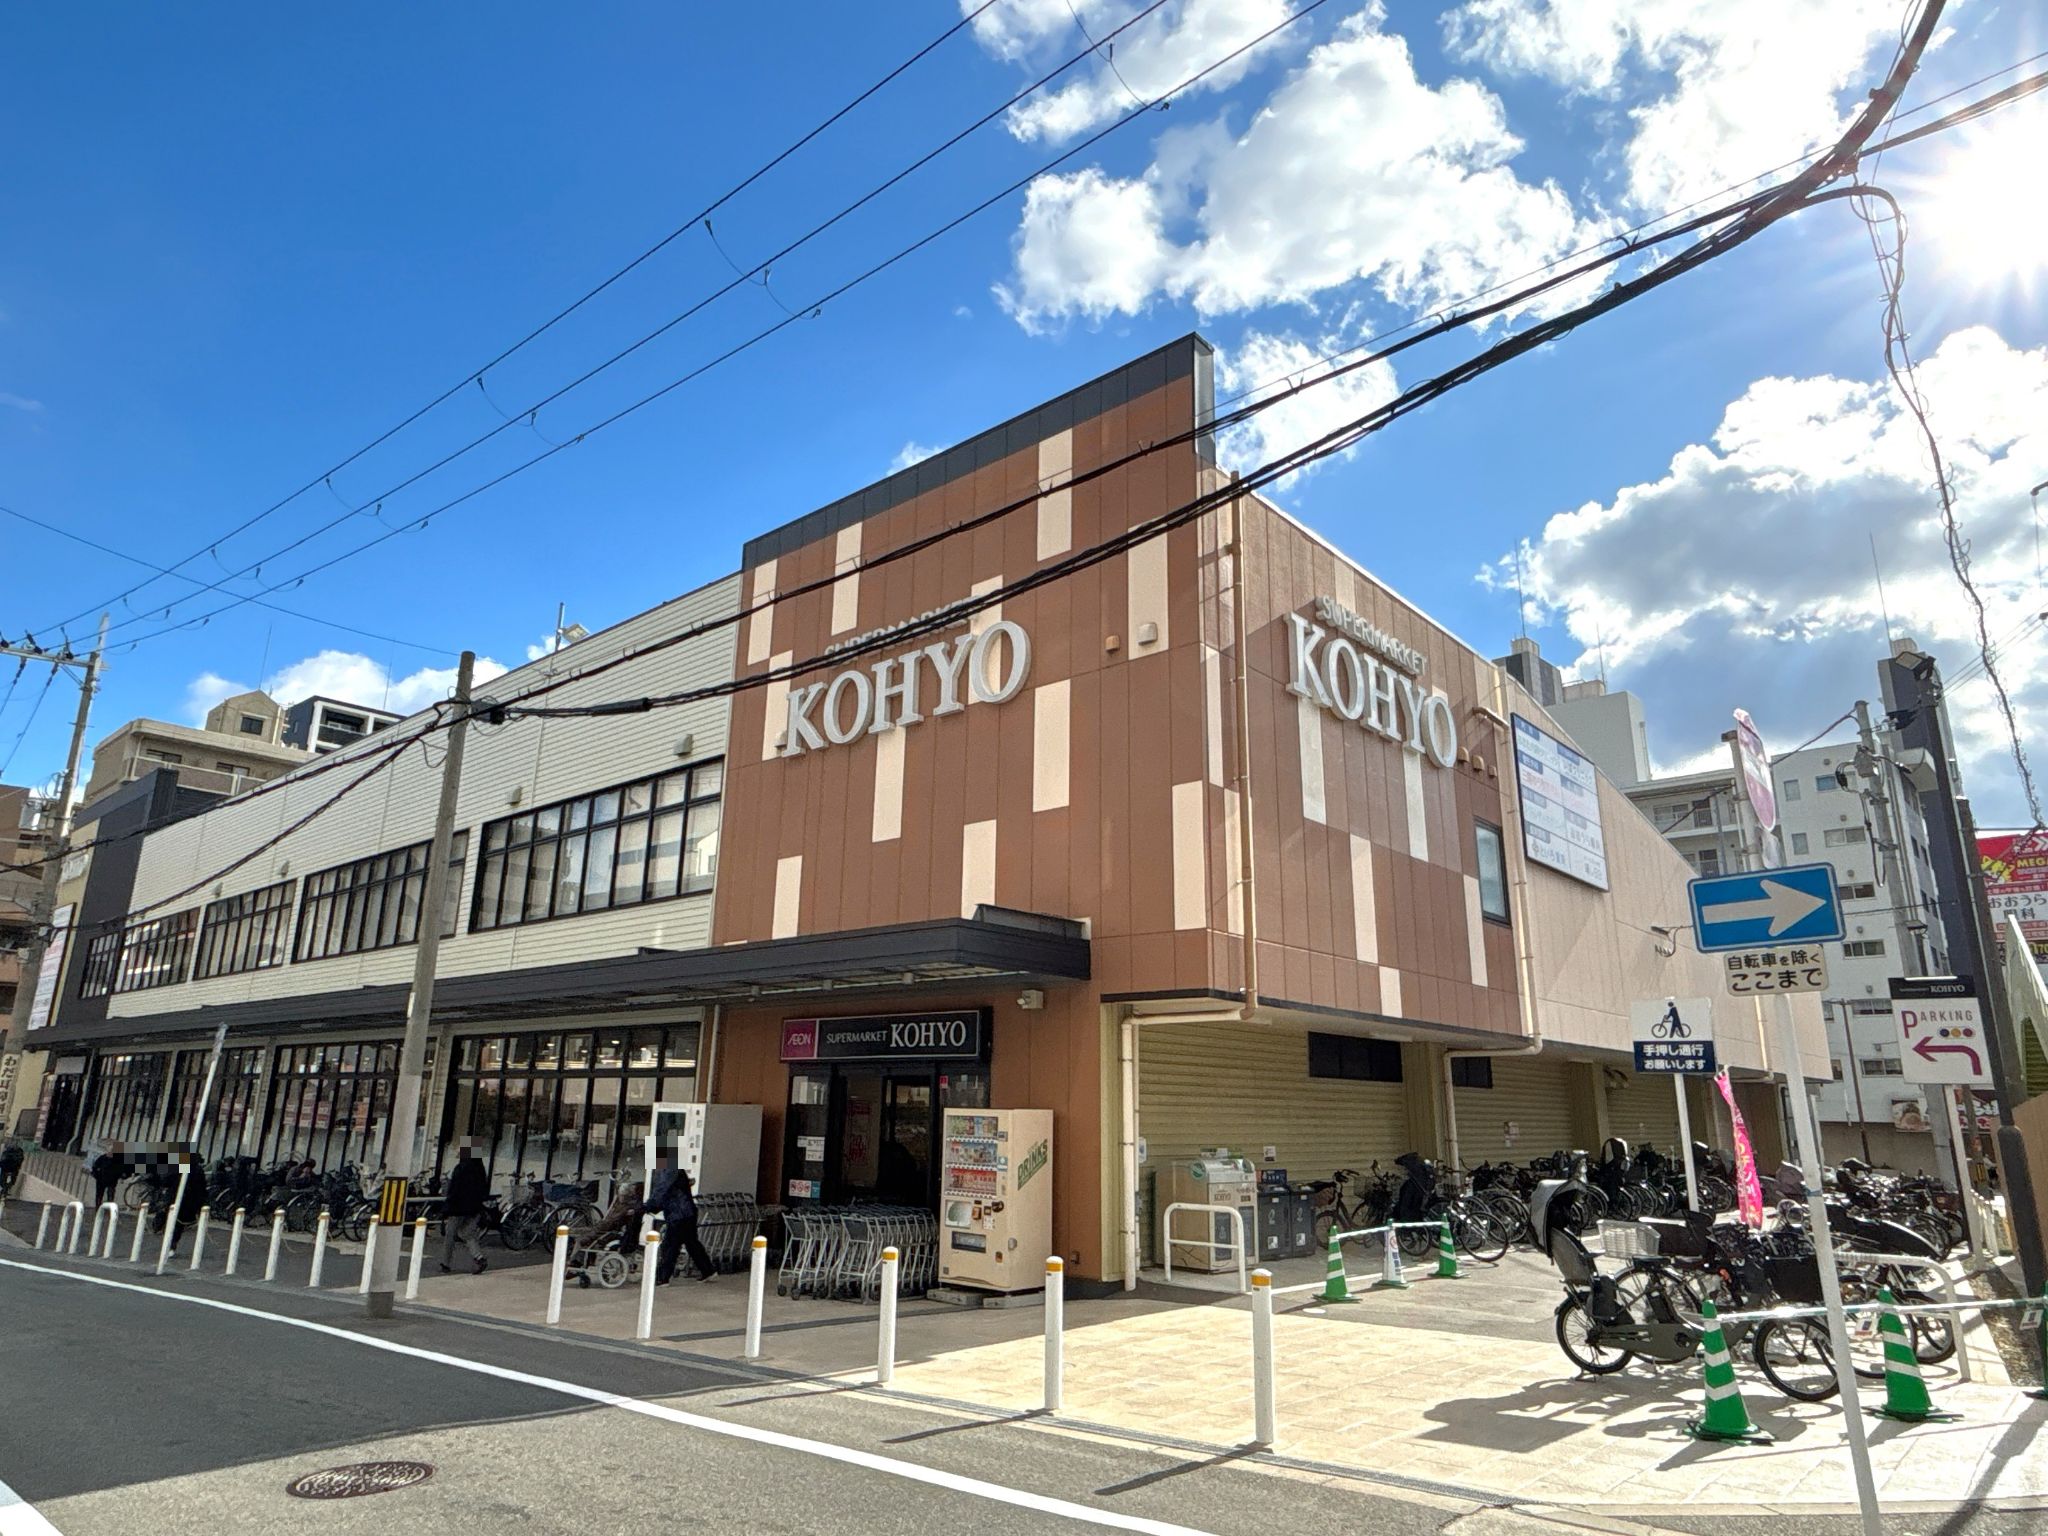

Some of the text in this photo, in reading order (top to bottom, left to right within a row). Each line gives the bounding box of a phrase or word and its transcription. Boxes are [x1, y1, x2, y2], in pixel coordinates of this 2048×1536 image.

[1314, 595, 1428, 677] SUPERMARKET
[781, 620, 1032, 758] KOHYO
[1283, 612, 1458, 768] KOHYO
[2016, 857, 2048, 868] MEG
[1988, 894, 2047, 909] おおうら
[1728, 950, 1820, 970] 自転車を除く
[1732, 968, 1822, 991] ここまで
[1930, 984, 1966, 993] KOHYO
[826, 1030, 888, 1044] SUPERMARKET
[890, 1020, 967, 1048] KOHYO
[1901, 1009, 1974, 1039] PARKING
[1643, 1044, 1704, 1056] 手押し通行
[1644, 1060, 1706, 1070] お願いします
[1017, 1139, 1048, 1180] DRINKS
